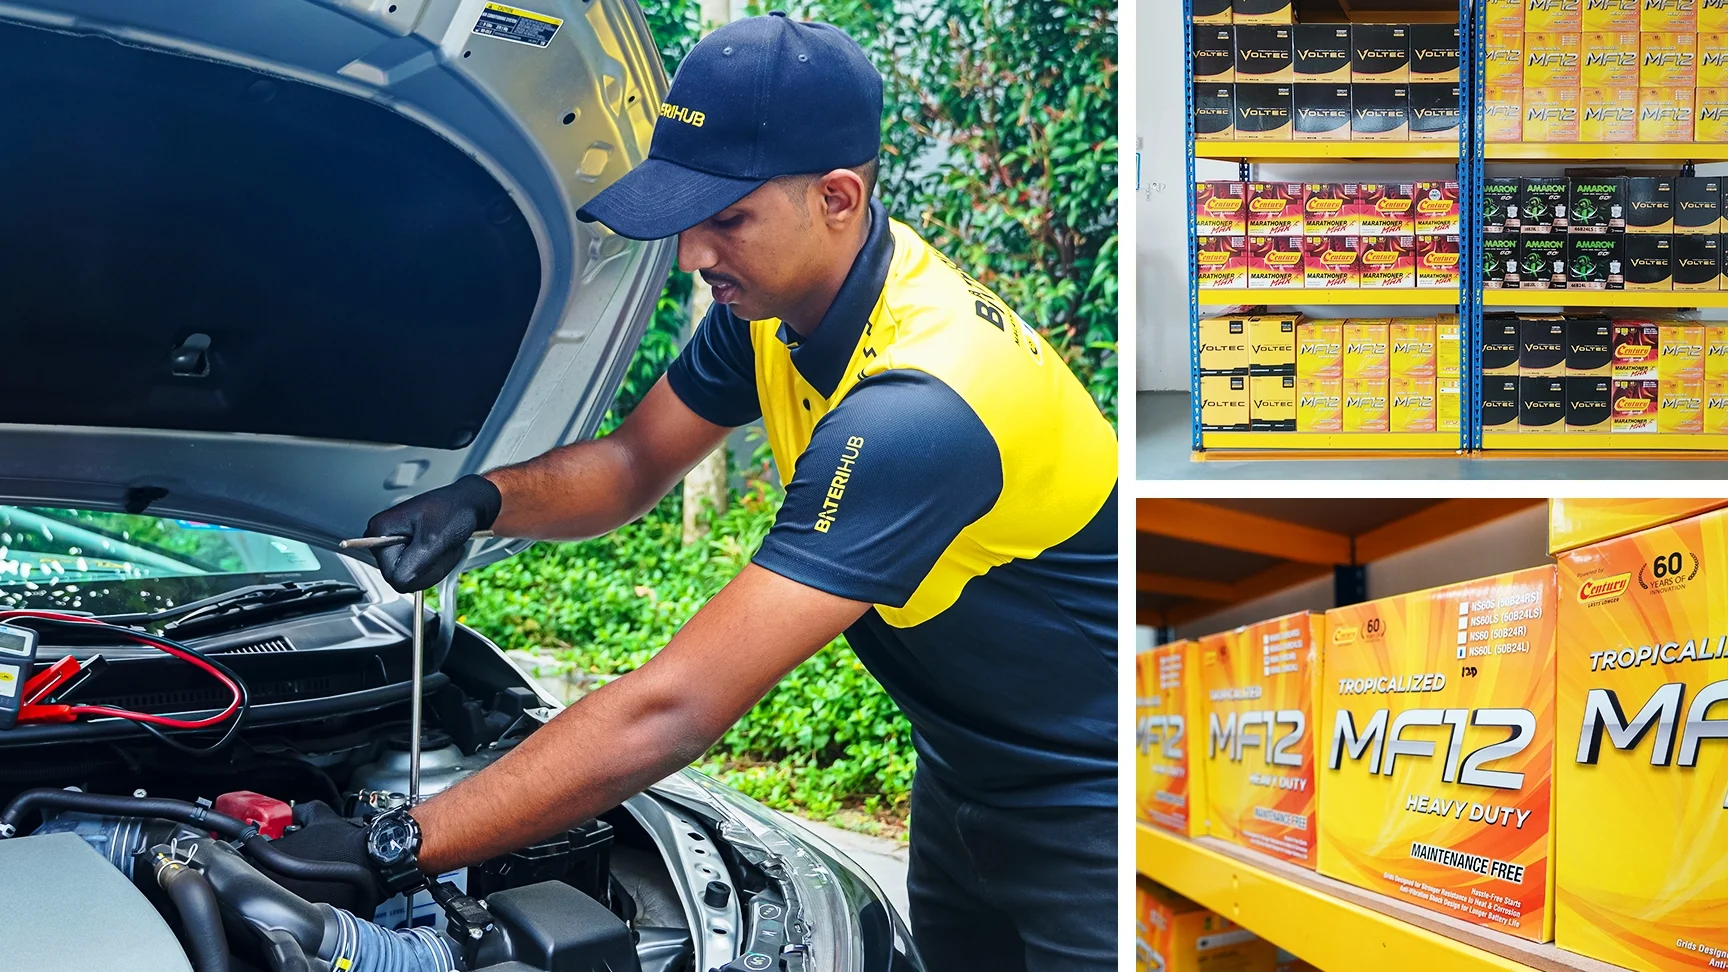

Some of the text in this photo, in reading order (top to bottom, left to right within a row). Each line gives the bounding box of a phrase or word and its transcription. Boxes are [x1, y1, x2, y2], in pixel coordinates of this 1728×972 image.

[1241, 49, 1288, 60] VOLTEC
[1297, 49, 1345, 60] VOLTEC
[1357, 49, 1404, 60] VOLTEC
[1528, 53, 1578, 66] MF12
[1586, 52, 1637, 66] MF12
[1644, 53, 1694, 66] MF12
[1240, 108, 1287, 118] VOLTEC
[1298, 109, 1345, 120] VOLTEC
[1356, 108, 1403, 120] VOLTEC
[1527, 107, 1577, 121] MF12
[1584, 107, 1636, 121] MF12
[1641, 107, 1692, 121] MF12
[1632, 201, 1669, 210] VOLTEC
[1680, 201, 1716, 210] VOLTEC
[1631, 258, 1668, 267] VOLTEC
[1679, 259, 1715, 267] VOLTEC
[1252, 344, 1292, 354] VOLTEC
[1300, 344, 1340, 354] MF12
[1347, 343, 1386, 354] MF12
[1394, 342, 1433, 354] MF12
[1525, 344, 1560, 352] VOLTEC
[1571, 345, 1608, 353] VOLTEC
[1662, 345, 1702, 356] MF12
[1254, 400, 1293, 409] VOLTEC
[1300, 396, 1340, 407] MF12
[1346, 397, 1385, 407] MF12
[1394, 396, 1433, 407] MF12
[1525, 400, 1560, 409] VOLTEC
[1571, 401, 1606, 410] VOLTEC
[1662, 398, 1701, 409] MF12
[814, 436, 864, 533] BATERIHUB
[1653, 552, 1682, 578] 60
[1650, 575, 1686, 588] YEARS OF
[1580, 577, 1627, 600] Century
[1650, 584, 1686, 595] INNOVATION
[1471, 600, 1495, 611] NS60S
[1471, 607, 1543, 627] NS60LS (50B24LS)
[1367, 618, 1379, 633] 60
[1470, 626, 1526, 642] NS60 (50B24R)
[1469, 641, 1529, 656] NS60L (50B24L)
[1590, 636, 1728, 671] TROPICALI
[1338, 673, 1446, 695] TROPICALIZED
[1209, 710, 1305, 766] MF12
[1328, 708, 1536, 790] MF12
[1250, 775, 1307, 792] HEAVY DUTY
[1406, 795, 1532, 829] HEAVY DUTY
[1411, 843, 1523, 882] MAINTENANCE FREE
[1442, 888, 1467, 902] Resistance
[1474, 898, 1486, 908] Heat
[1493, 904, 1521, 917] Corrosion
[1471, 888, 1521, 908] Hassle-Free Starts
[1429, 894, 1443, 904] Shock
[1444, 898, 1460, 910] Design
[1469, 906, 1487, 918] Longer
[1488, 911, 1508, 925] Battery
[1508, 916, 1520, 928] Life
[1676, 939, 1728, 958] Grids Design
[1709, 958, 1728, 969] Anti-
